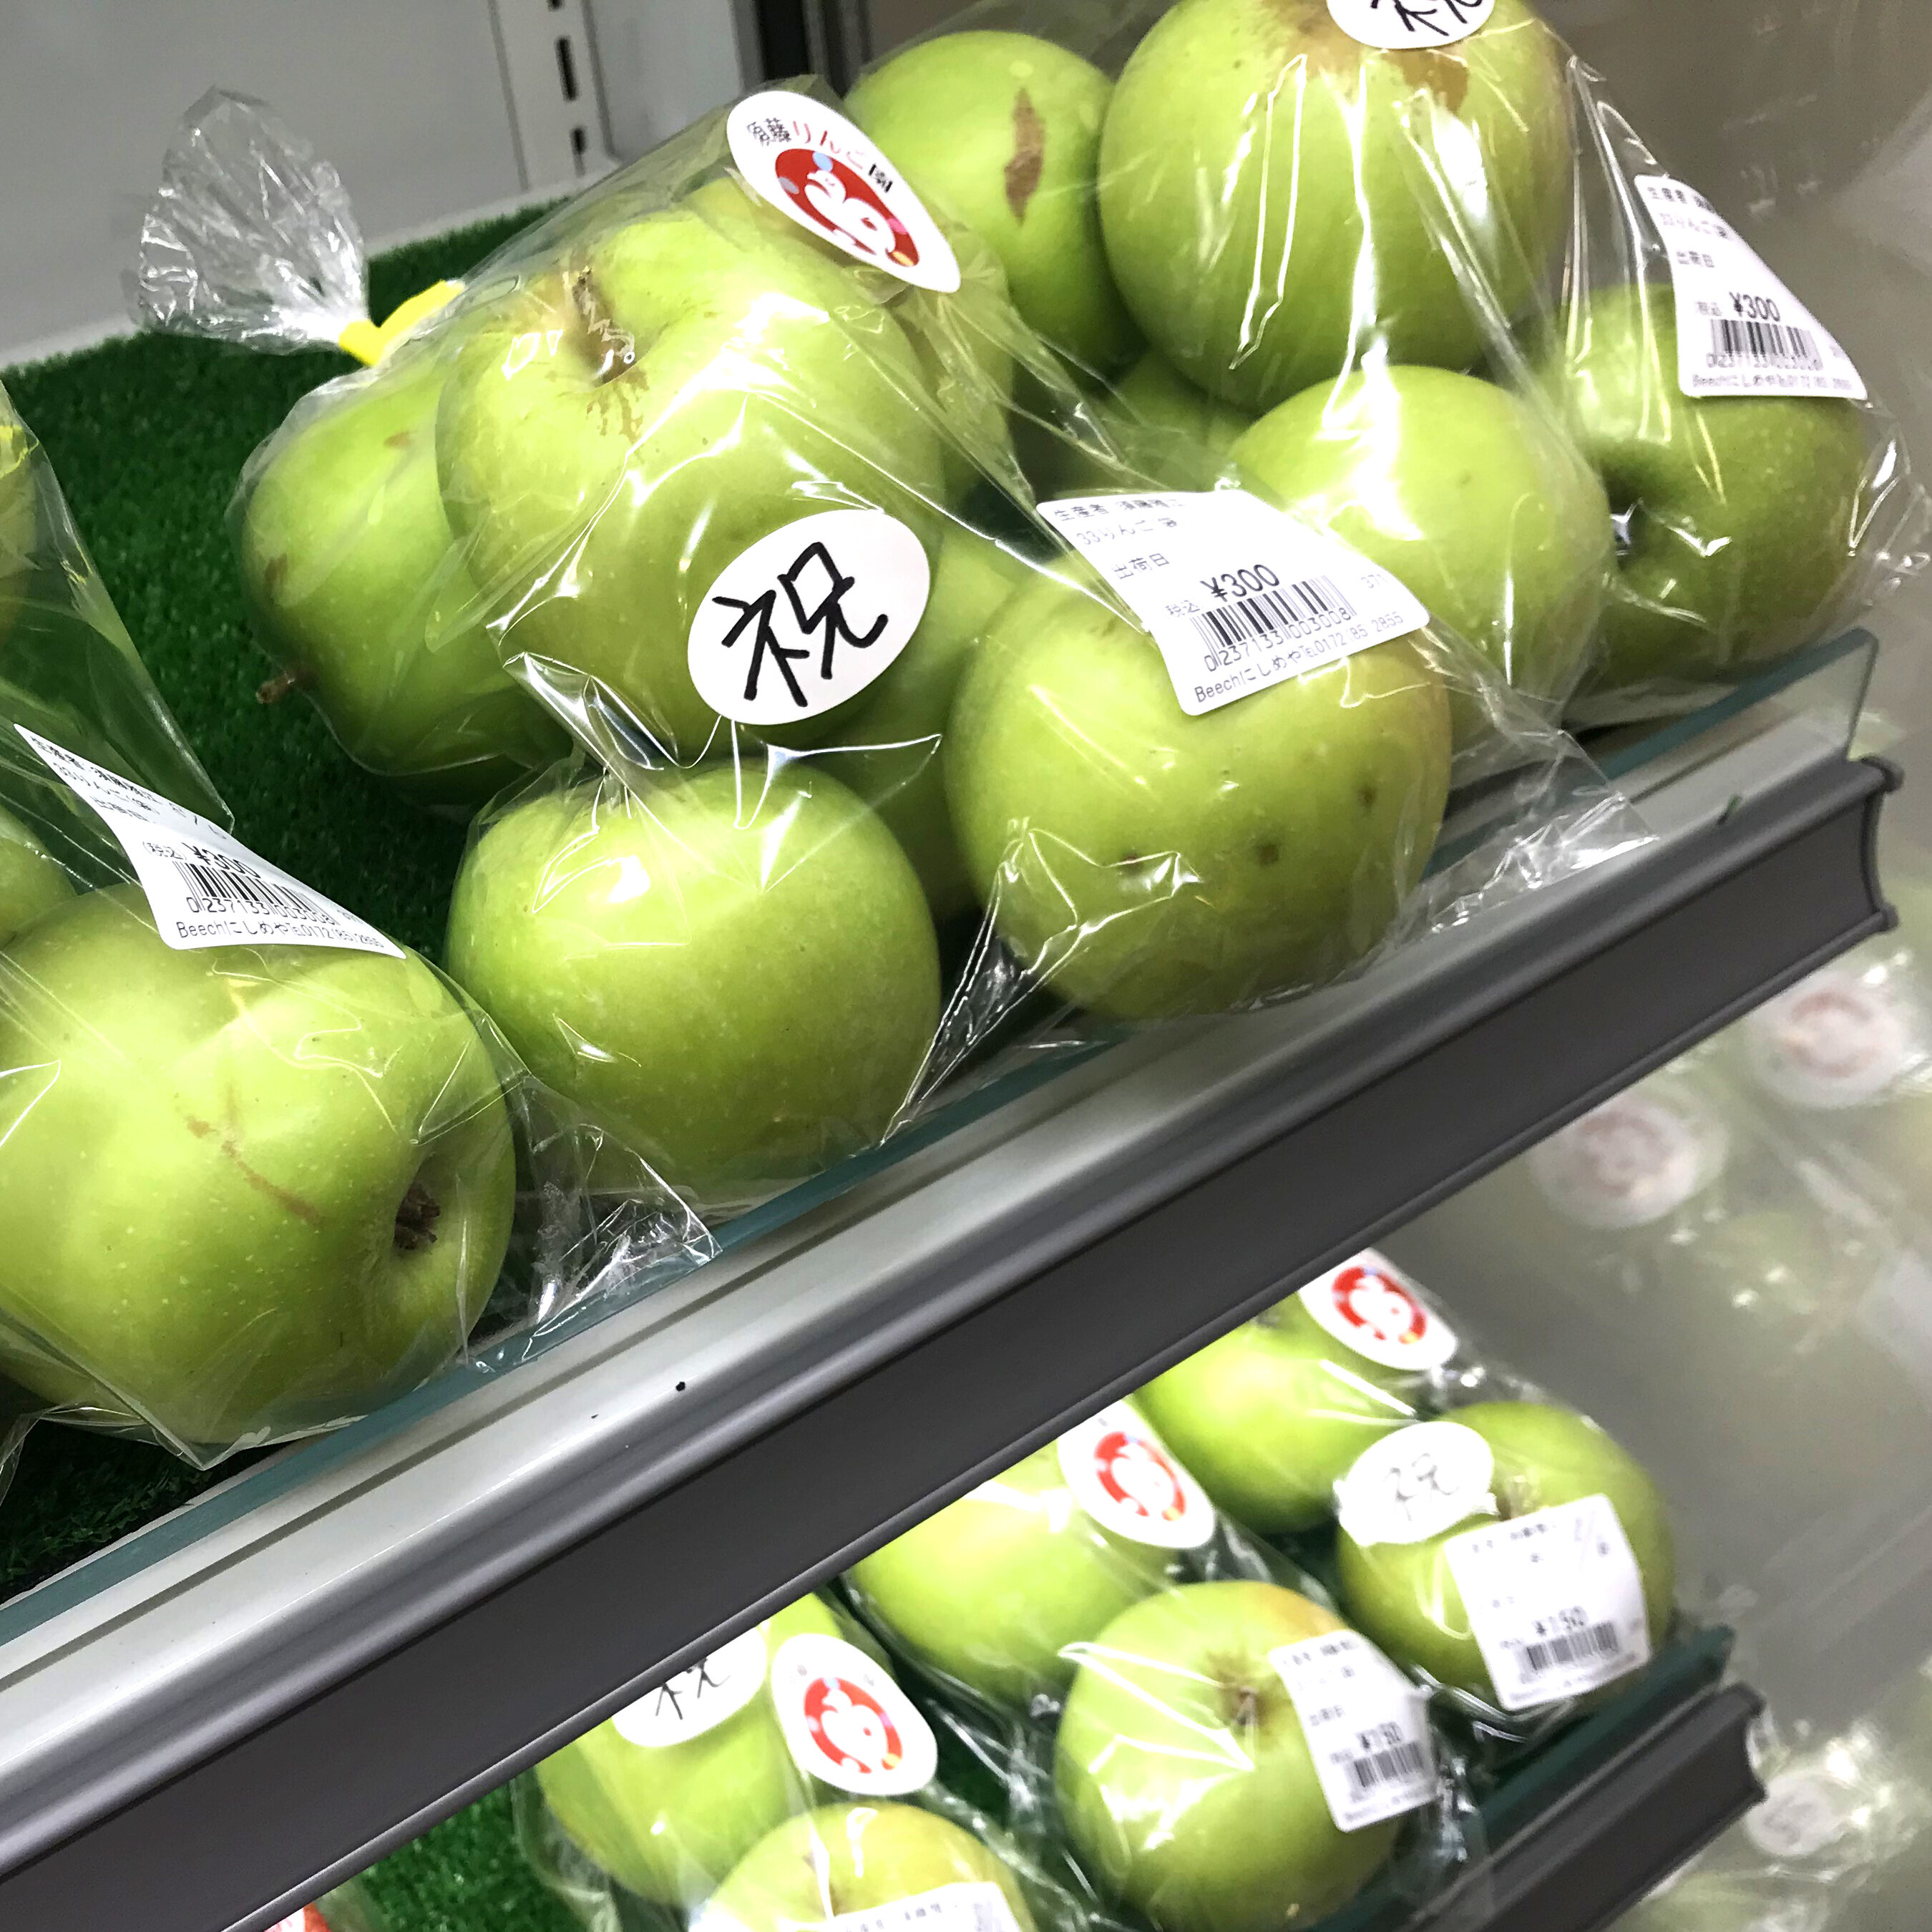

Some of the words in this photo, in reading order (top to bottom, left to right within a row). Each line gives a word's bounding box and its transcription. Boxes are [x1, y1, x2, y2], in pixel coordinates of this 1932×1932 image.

[1729, 291, 1780, 321] ¥300
[1111, 553, 1170, 580] 出荷日
[1200, 564, 1279, 602] ¥300
[712, 542, 889, 708] 祝
[182, 842, 262, 879] ¥300
